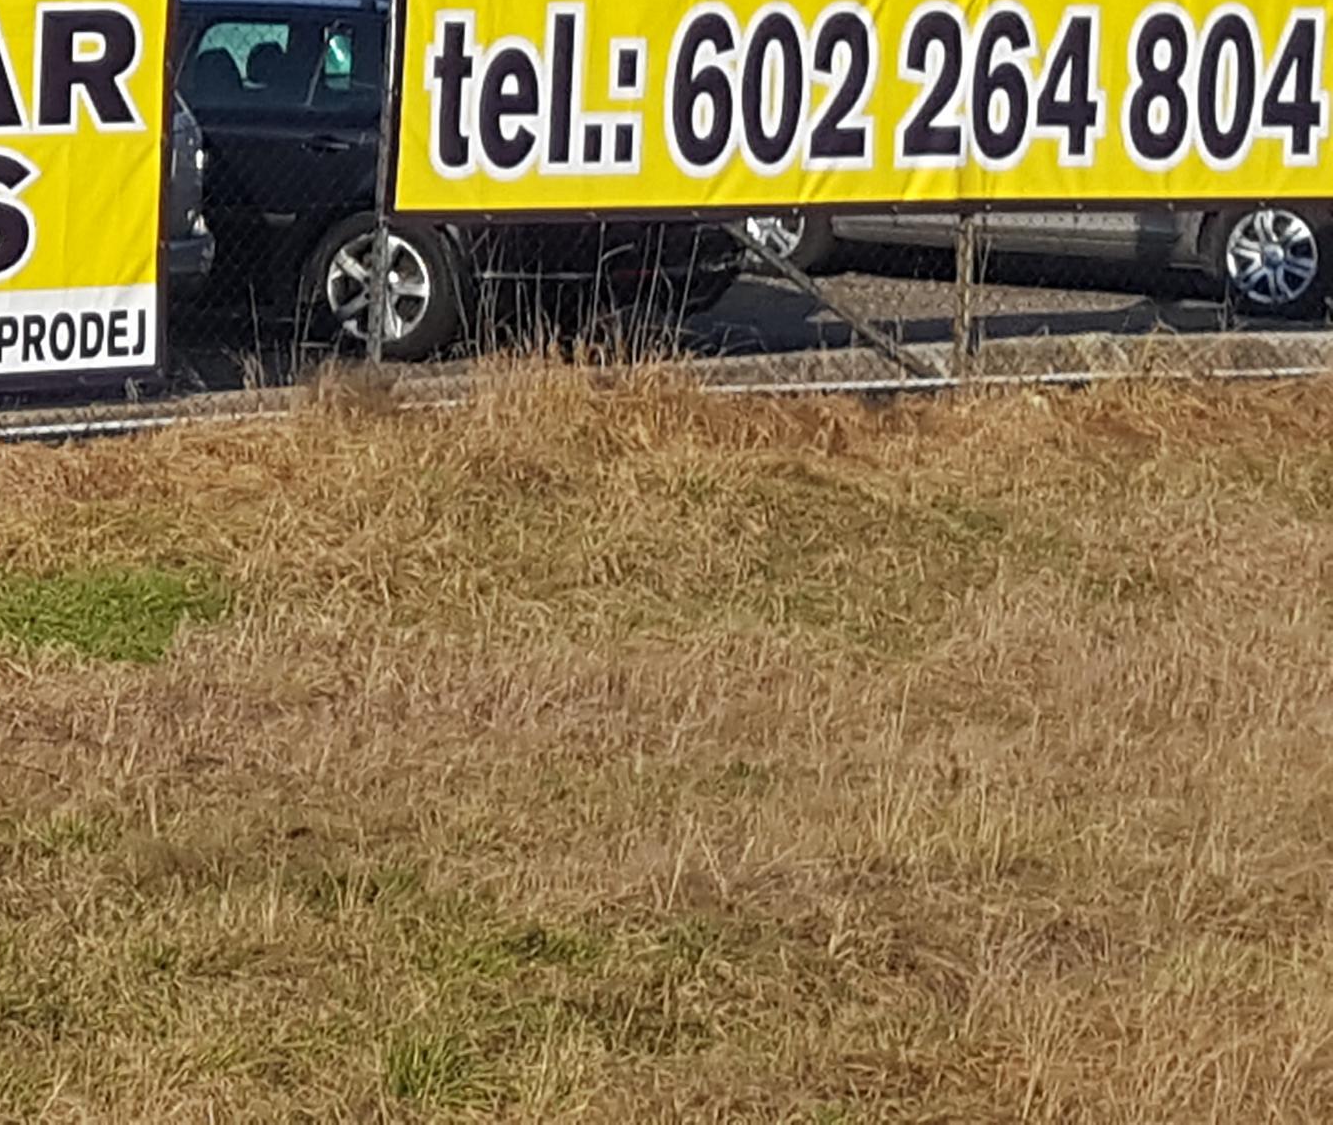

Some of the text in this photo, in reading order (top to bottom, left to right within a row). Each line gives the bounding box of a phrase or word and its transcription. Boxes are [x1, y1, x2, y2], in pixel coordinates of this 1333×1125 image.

[433, 10, 1323, 170] tel.: 602 264 804
